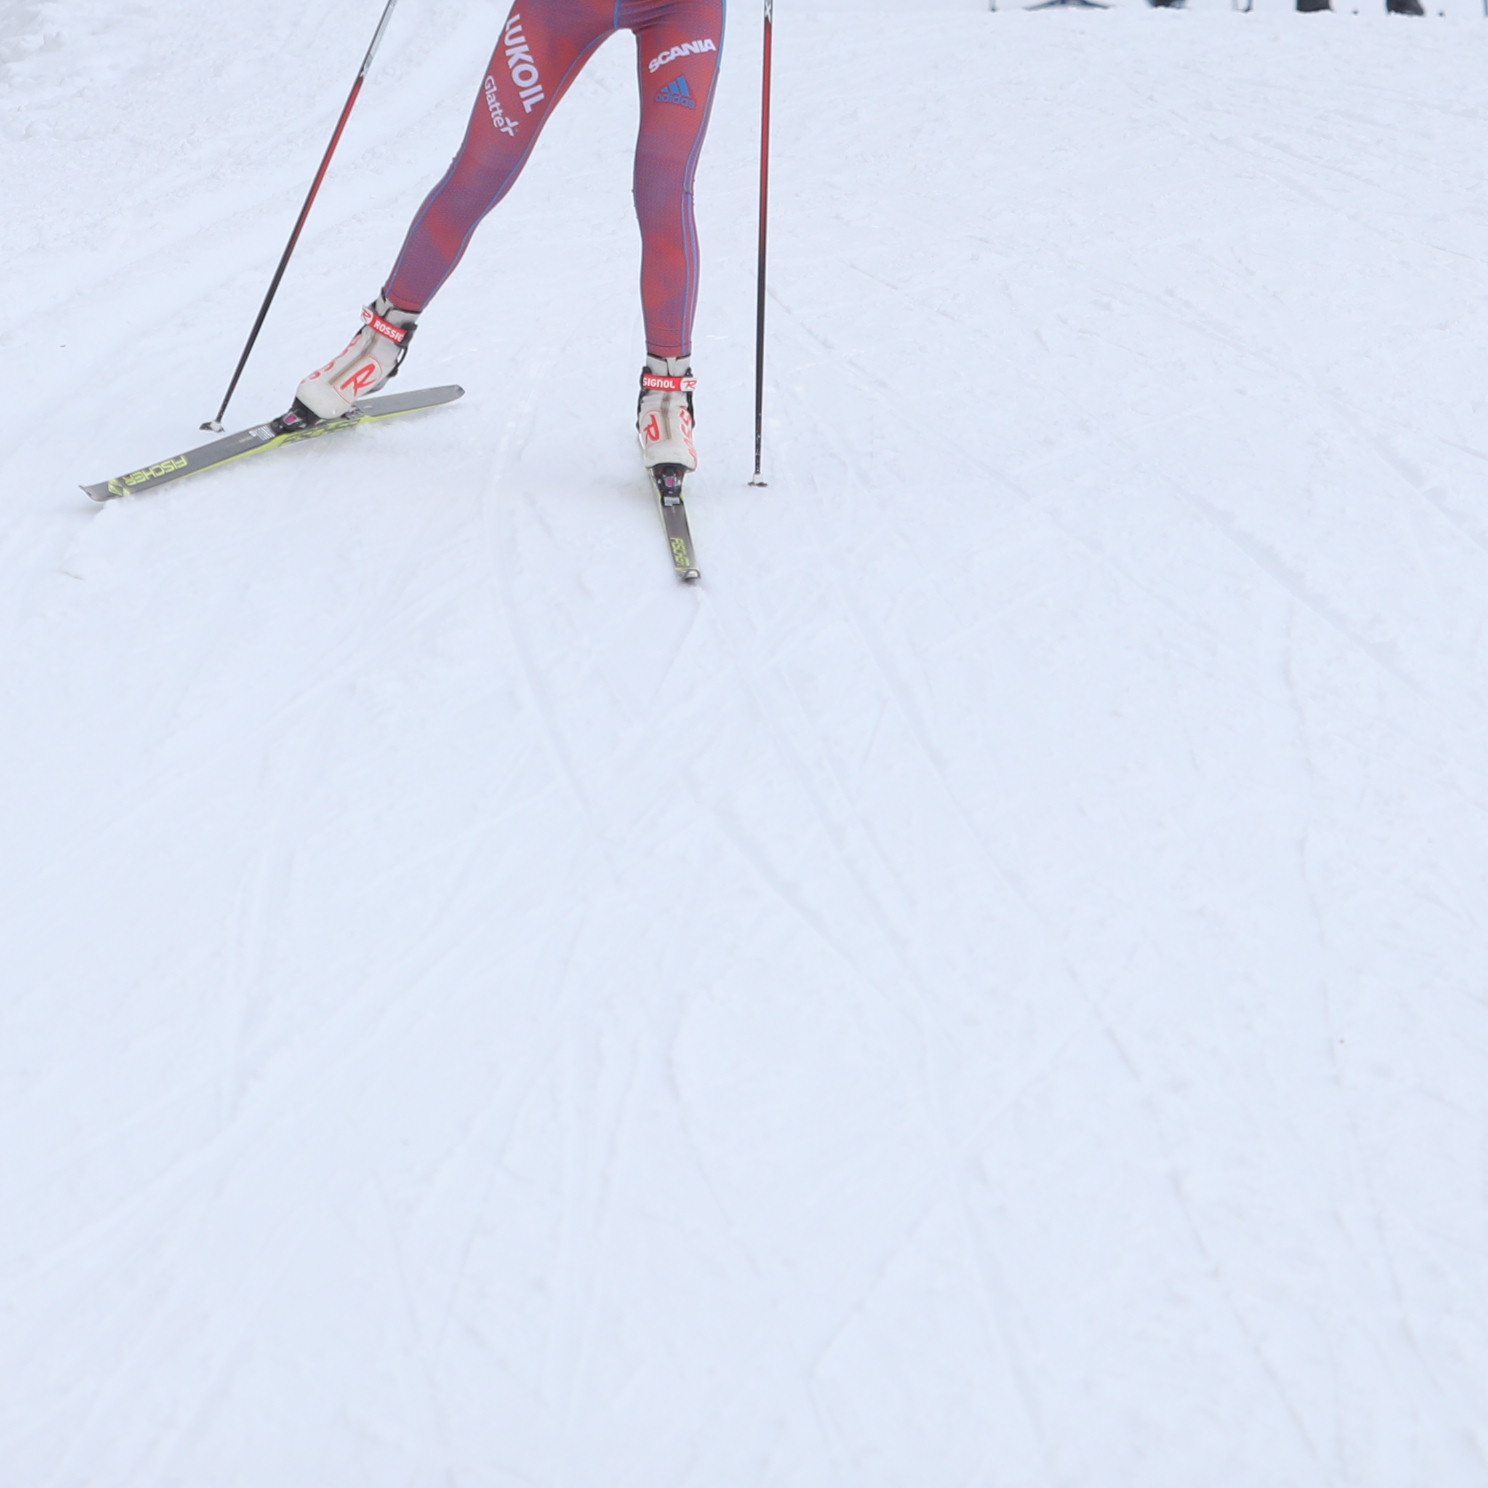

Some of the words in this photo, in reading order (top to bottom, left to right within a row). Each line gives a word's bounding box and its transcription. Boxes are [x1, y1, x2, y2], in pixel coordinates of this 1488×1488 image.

[503, 13, 545, 114] LUKOIL
[648, 38, 716, 74] SCANIA
[123, 455, 188, 487] FISCHER
